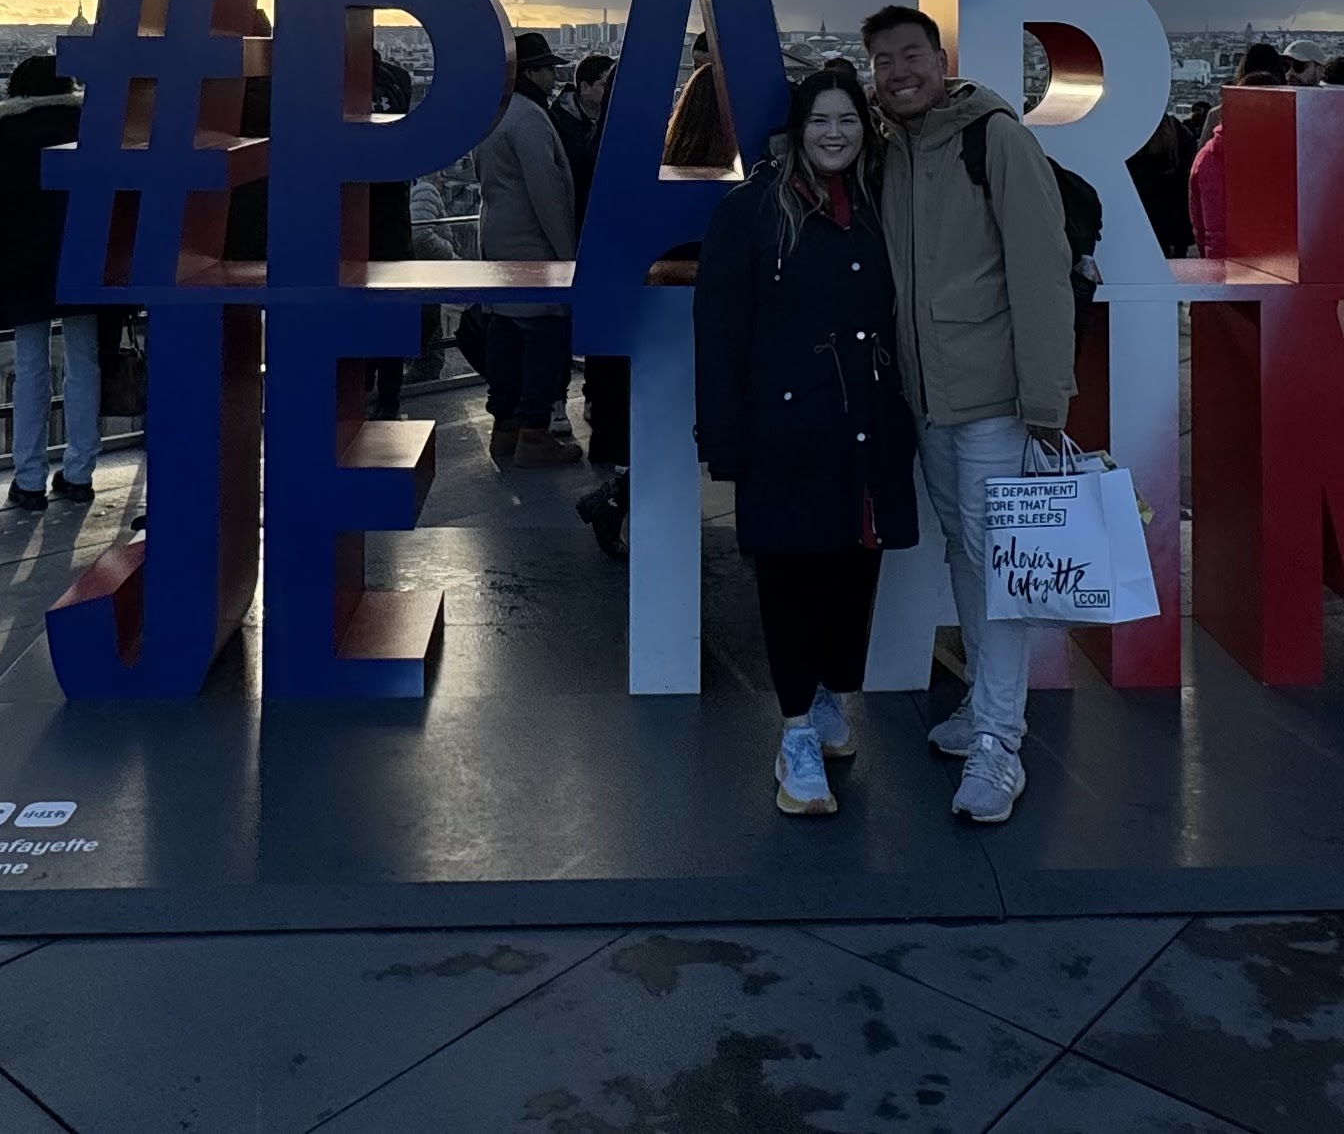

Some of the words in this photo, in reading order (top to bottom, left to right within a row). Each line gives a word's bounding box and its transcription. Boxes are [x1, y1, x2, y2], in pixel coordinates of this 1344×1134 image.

[45, 287, 446, 699] JE
[985, 487, 999, 498] HE
[1001, 485, 1074, 497] DEPARTMENT
[985, 500, 1015, 512] TORE
[1019, 499, 1047, 511] THAT
[985, 514, 1015, 527] EVER
[1017, 513, 1063, 525] SLEEPS
[992, 535, 1055, 578] Galeries
[1007, 557, 1093, 604] Lafayette
[1076, 593, 1107, 605] .COM
